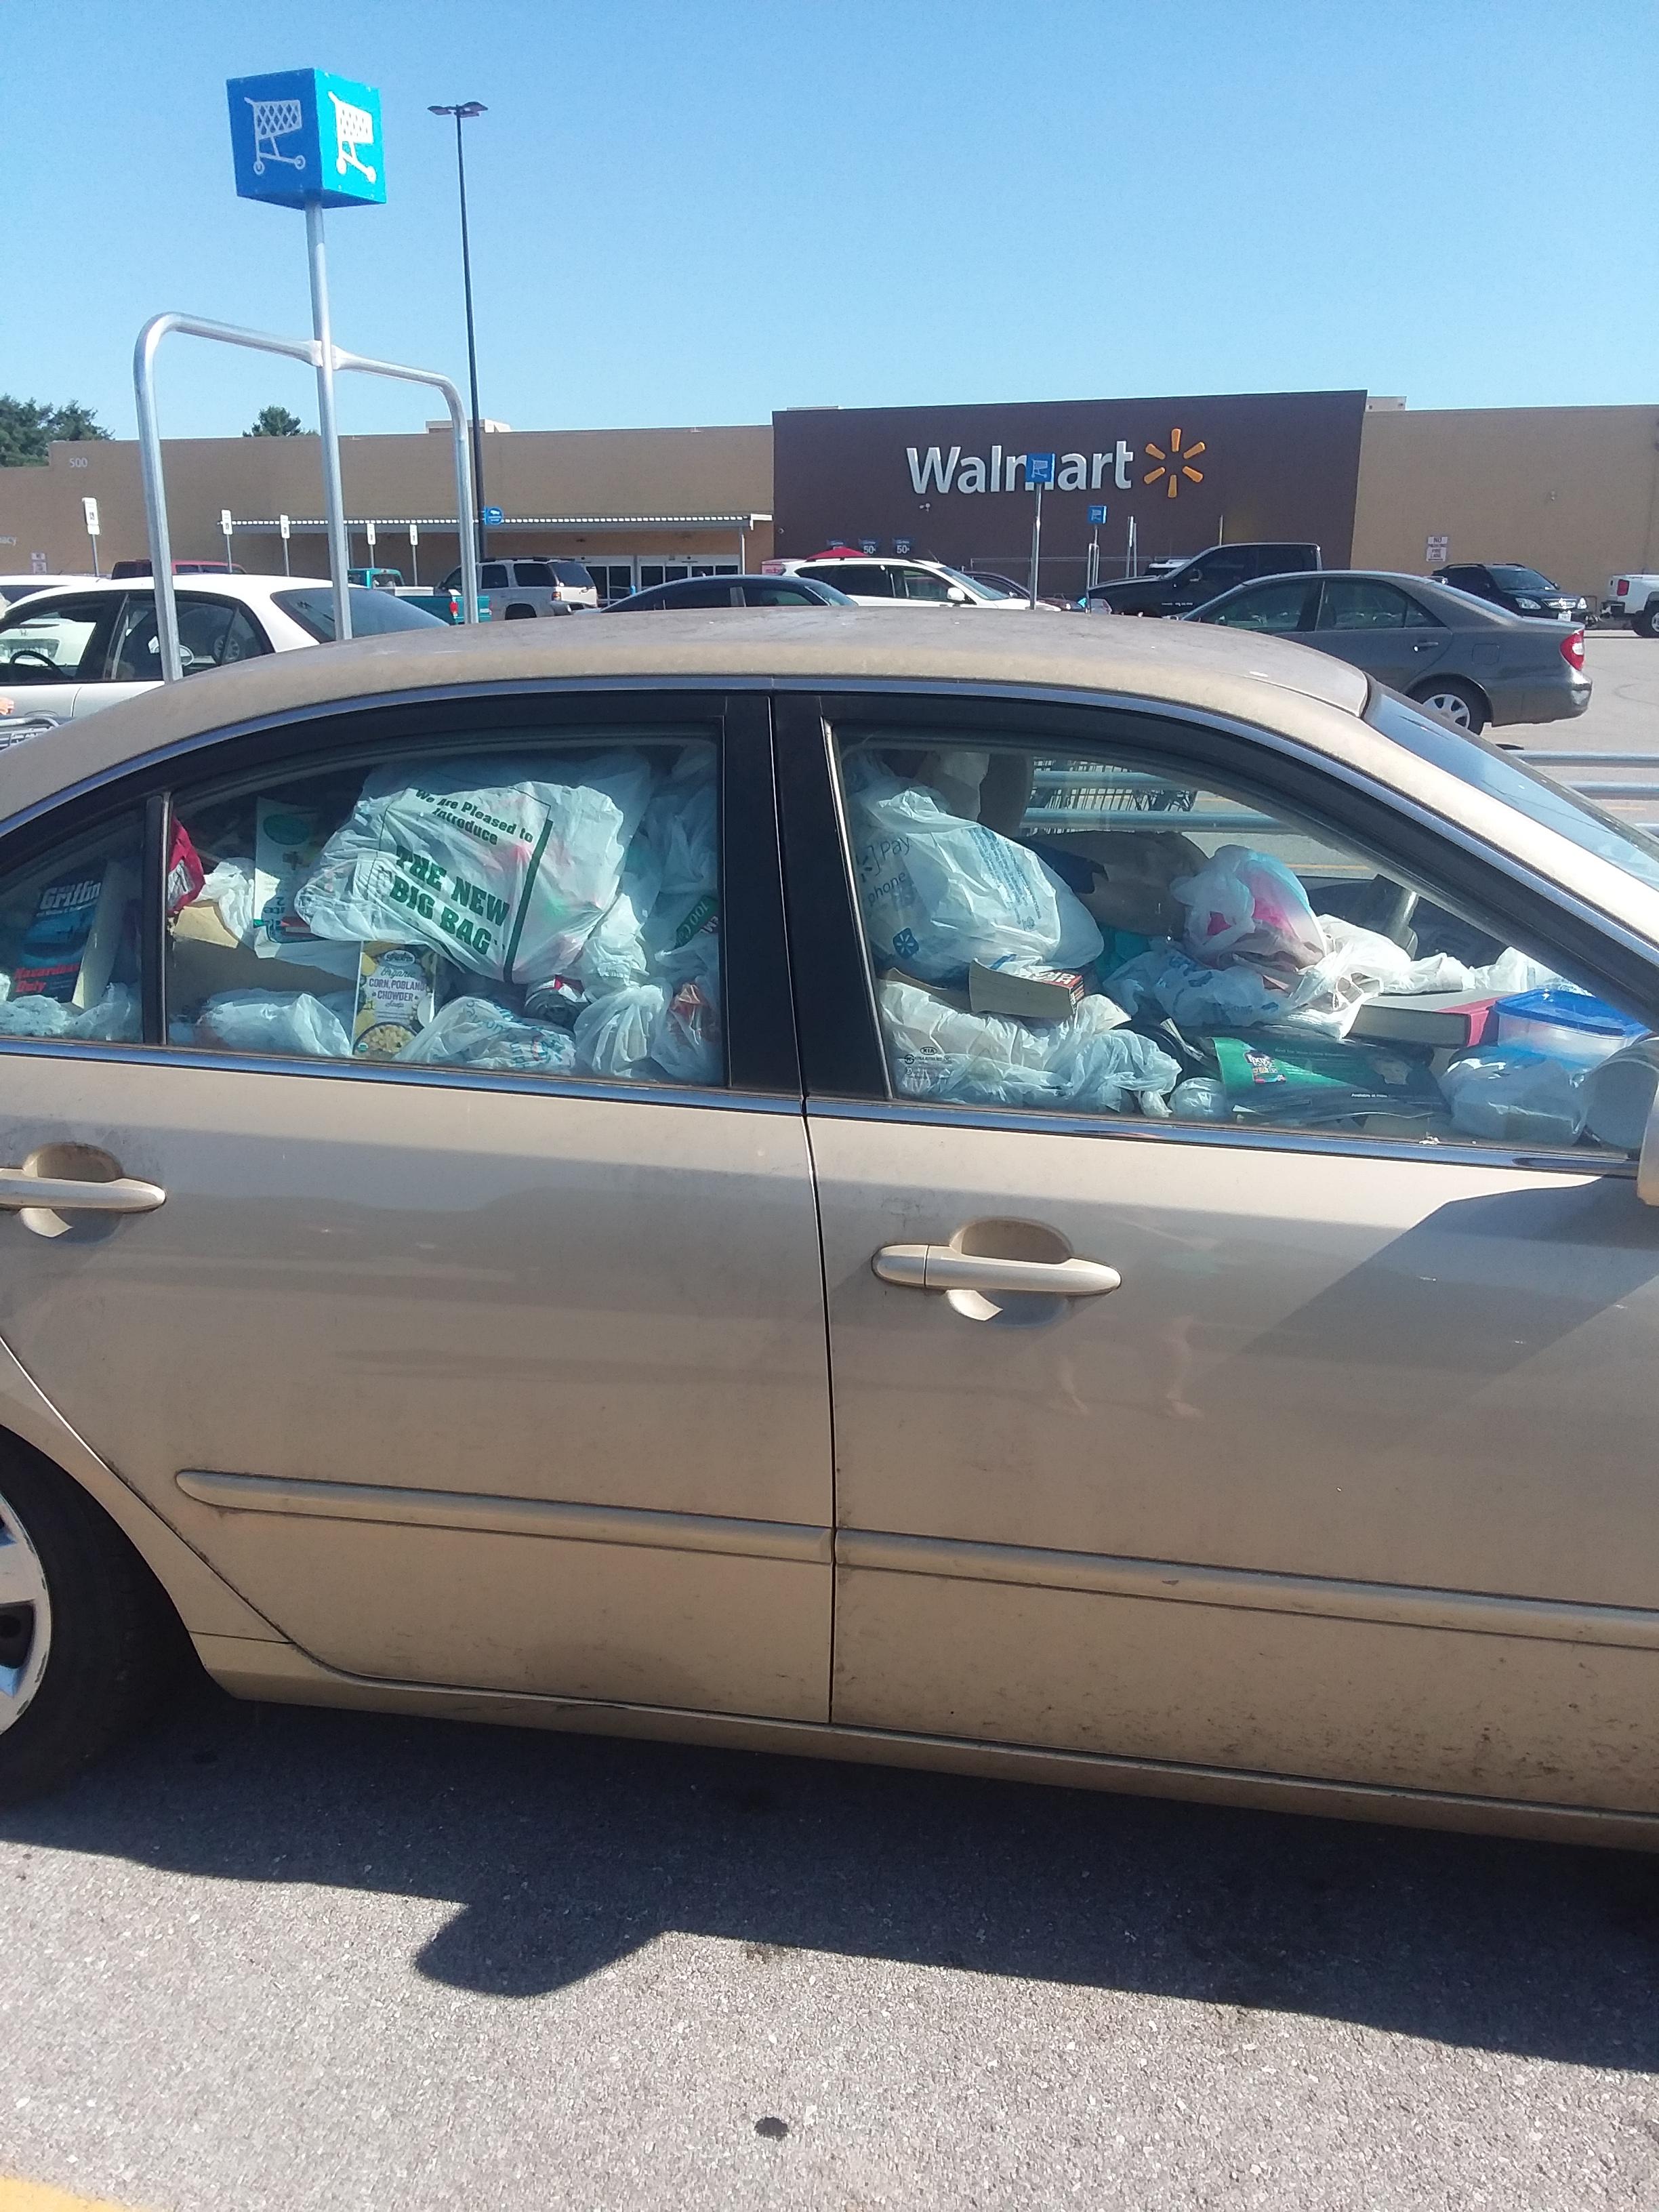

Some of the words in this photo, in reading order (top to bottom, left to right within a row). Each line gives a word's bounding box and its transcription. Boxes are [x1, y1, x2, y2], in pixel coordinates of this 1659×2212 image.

[70, 457, 88, 468] 500
[415, 789, 435, 804] We
[436, 798, 457, 809] Are
[461, 801, 517, 835] Pleased
[519, 827, 534, 843] to
[432, 807, 498, 846] Introduce
[880, 836, 910, 861] Pay
[40, 880, 102, 910] Griffin
[396, 845, 447, 892] THE
[451, 876, 510, 927] NEW
[867, 872, 906, 907] phone
[389, 875, 436, 920] BIG
[440, 906, 492, 956] BAG
[689, 900, 709, 926] 100
[380, 965, 416, 979] Organic
[391, 980, 426, 991] POBLANO
[377, 990, 413, 1002] CHOWDER
